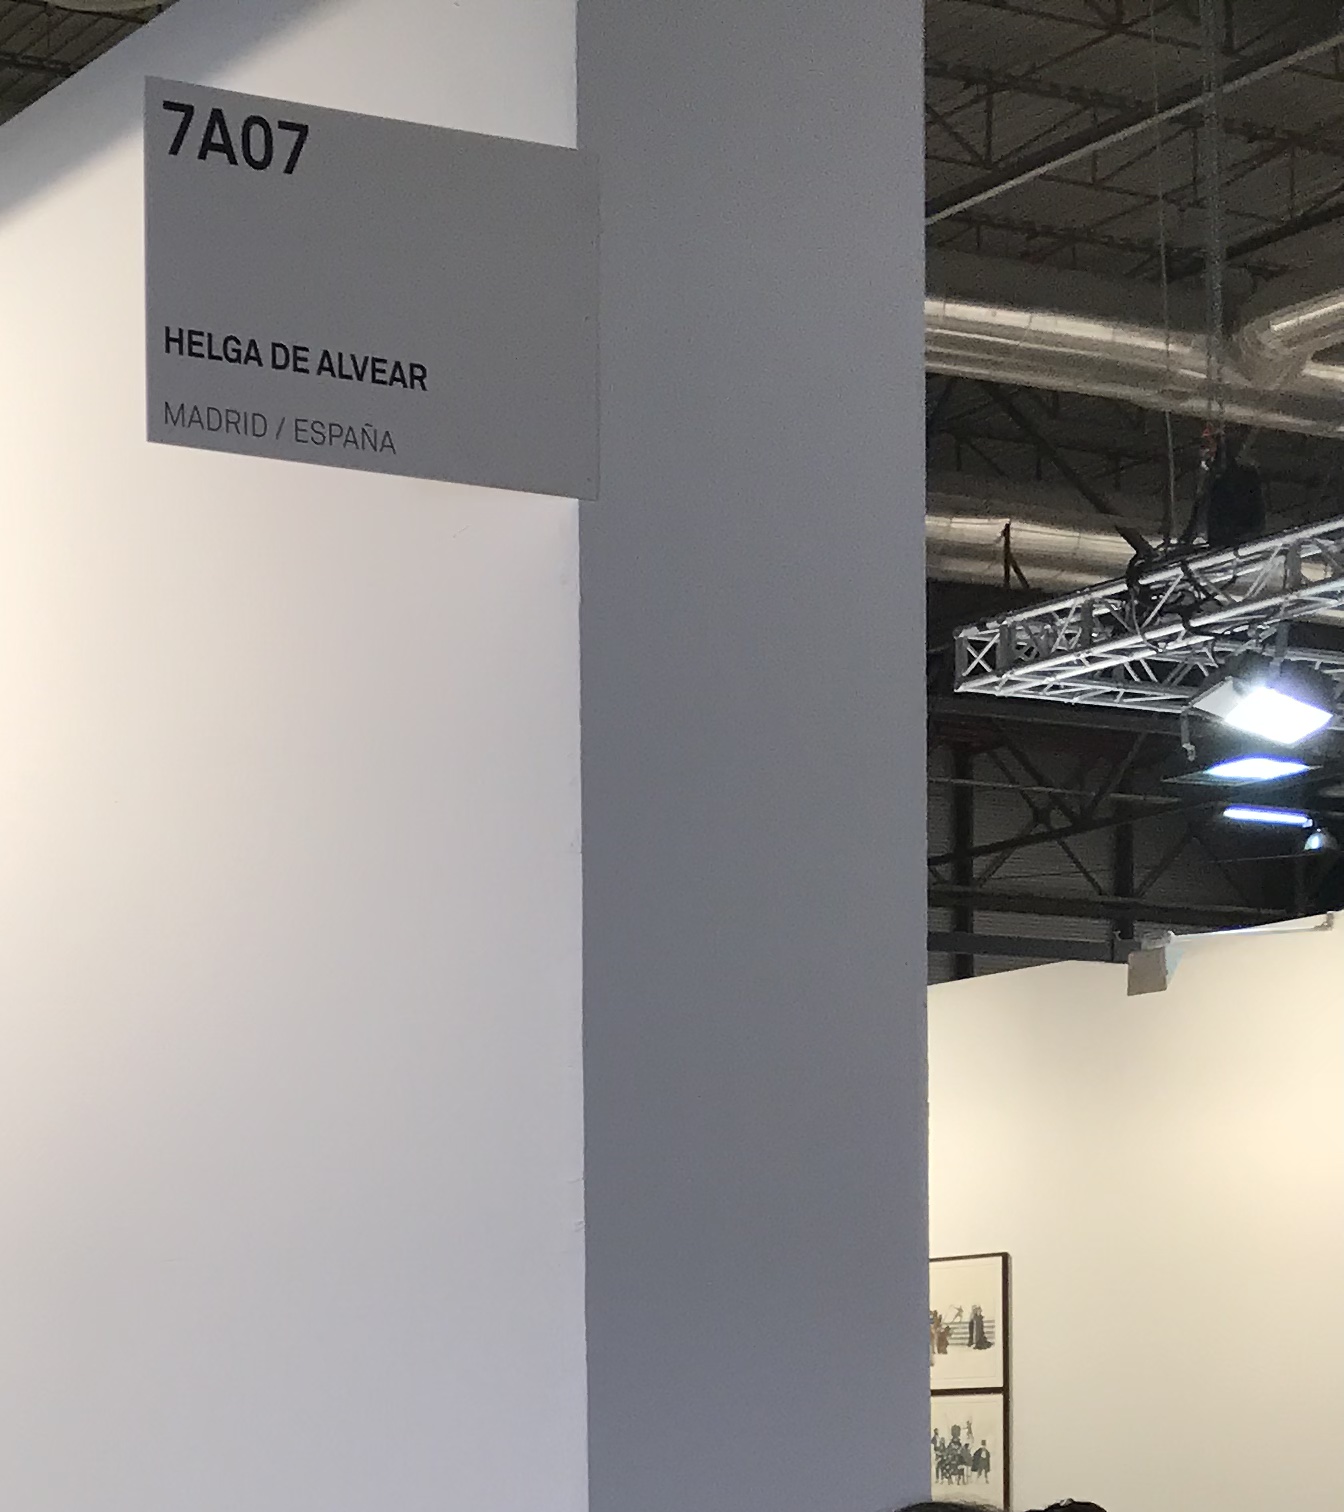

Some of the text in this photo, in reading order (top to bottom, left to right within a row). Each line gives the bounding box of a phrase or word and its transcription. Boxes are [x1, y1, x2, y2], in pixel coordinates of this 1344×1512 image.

[162, 100, 309, 175] 7A07
[164, 326, 429, 392] HELGA DE ALVEAR
[164, 401, 397, 455] MADRID / ESPAÑA
